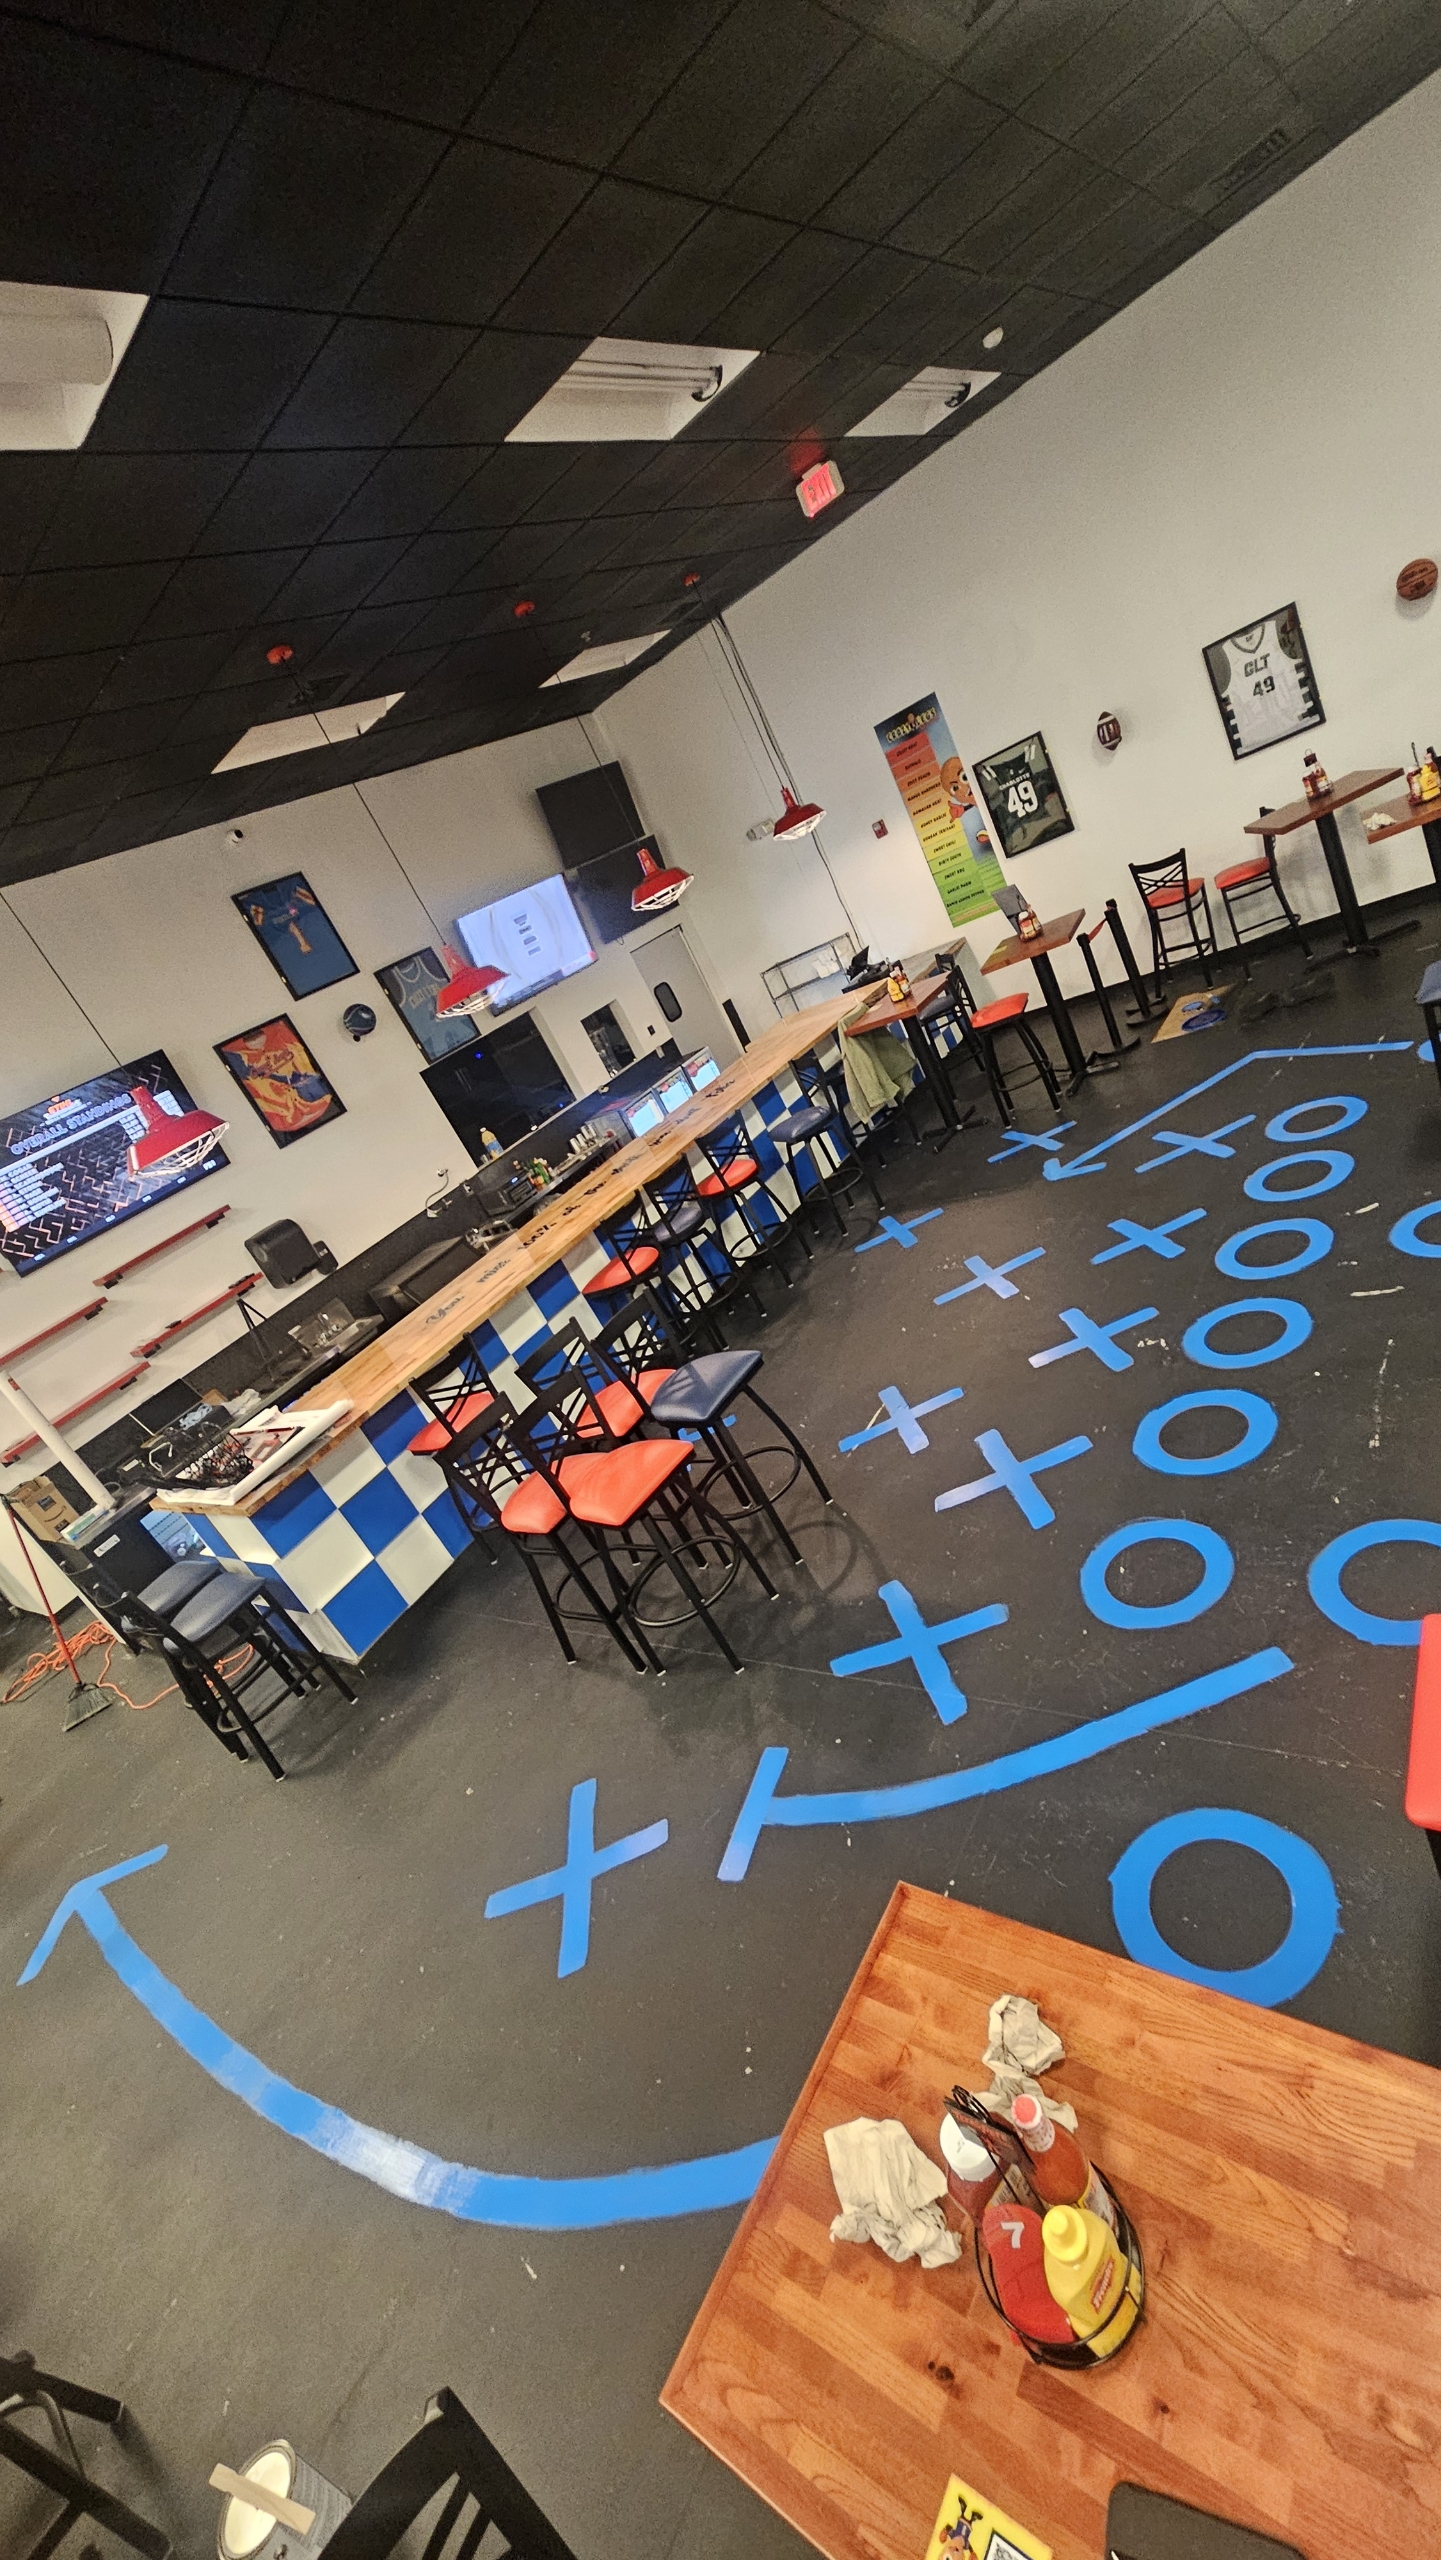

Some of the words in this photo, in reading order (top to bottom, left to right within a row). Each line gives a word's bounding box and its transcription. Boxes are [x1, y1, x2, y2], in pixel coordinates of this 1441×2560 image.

[1253, 676, 1275, 697] 49
[999, 773, 1030, 790] CHARLOTTE
[1008, 780, 1039, 819] 49
[11, 1124, 68, 1155] OVERALL
[67, 1094, 131, 1130] STANDINGS
[517, 1221, 557, 1251] 100%
[1000, 2221, 1025, 2249] 7
